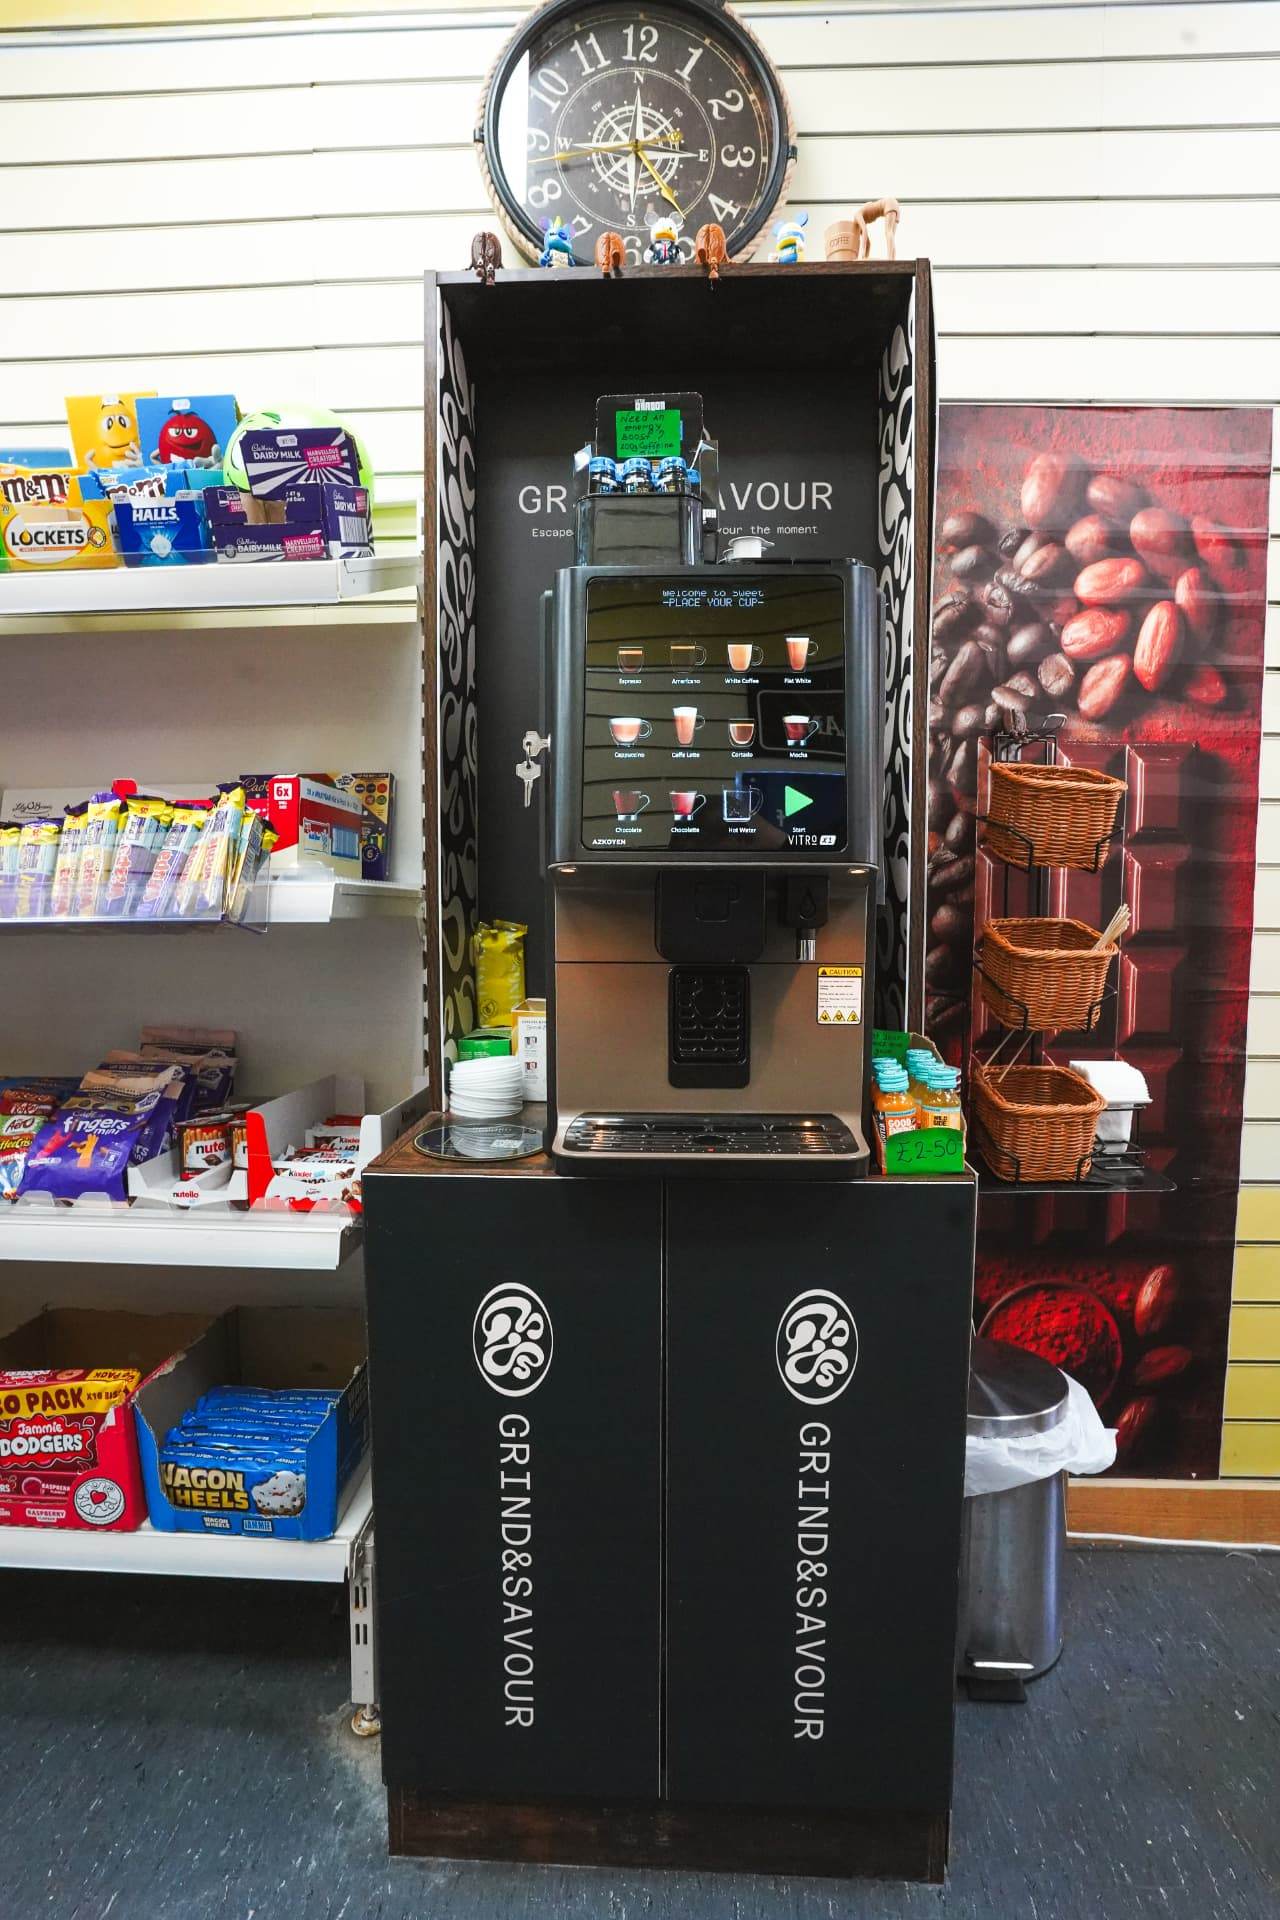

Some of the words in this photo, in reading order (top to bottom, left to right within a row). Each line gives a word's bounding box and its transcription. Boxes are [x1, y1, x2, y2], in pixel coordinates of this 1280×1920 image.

[622, 24, 659, 63] 12
[570, 32, 611, 76] 11
[675, 46, 703, 81] 1
[633, 71, 645, 84] N
[530, 67, 568, 114] 10
[707, 88, 744, 121] 2
[558, 137, 573, 150] W
[698, 149, 709, 162] E
[721, 144, 757, 168] 3
[528, 178, 562, 208] 8
[707, 192, 741, 223] 4
[626, 214, 636, 227] S
[253, 452, 279, 460] DAIRY
[280, 451, 301, 459] MILK
[132, 508, 177, 521] HALLS
[532, 529, 574, 538] Escape
[751, 525, 771, 534] the
[777, 526, 818, 535] moment
[11, 529, 85, 546] LOCKETS
[237, 545, 260, 553] DAIRY
[707, 598, 732, 607] YOUR
[276, 786, 289, 797] 6x
[64, 1116, 130, 1133] fingers
[196, 1141, 225, 1154] nute
[26, 1387, 85, 1412] PACK
[18, 1421, 63, 1435] Jammie
[0, 1434, 82, 1457] DODGERS
